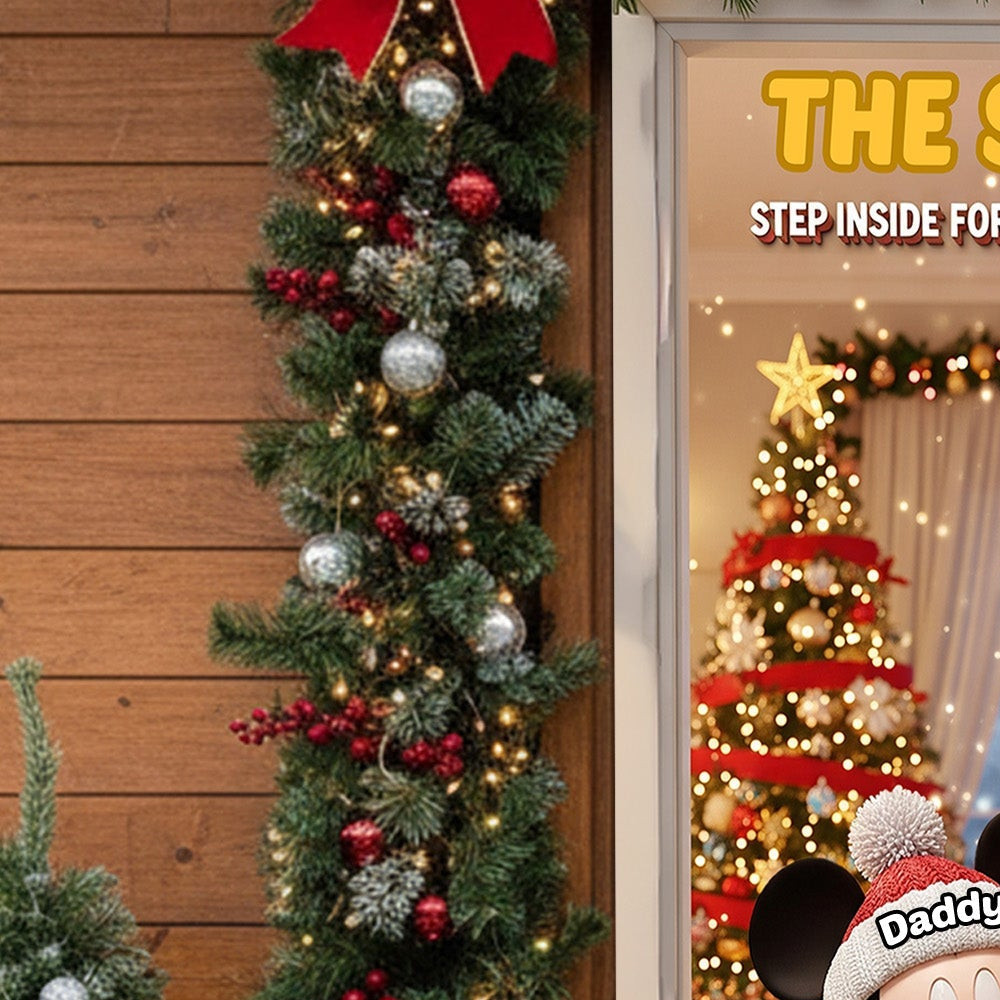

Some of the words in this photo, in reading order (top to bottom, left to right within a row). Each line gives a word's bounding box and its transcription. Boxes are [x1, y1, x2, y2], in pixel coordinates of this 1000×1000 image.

[763, 71, 959, 173] THE
[750, 201, 830, 239] STEP
[836, 202, 941, 241] INSIDE
